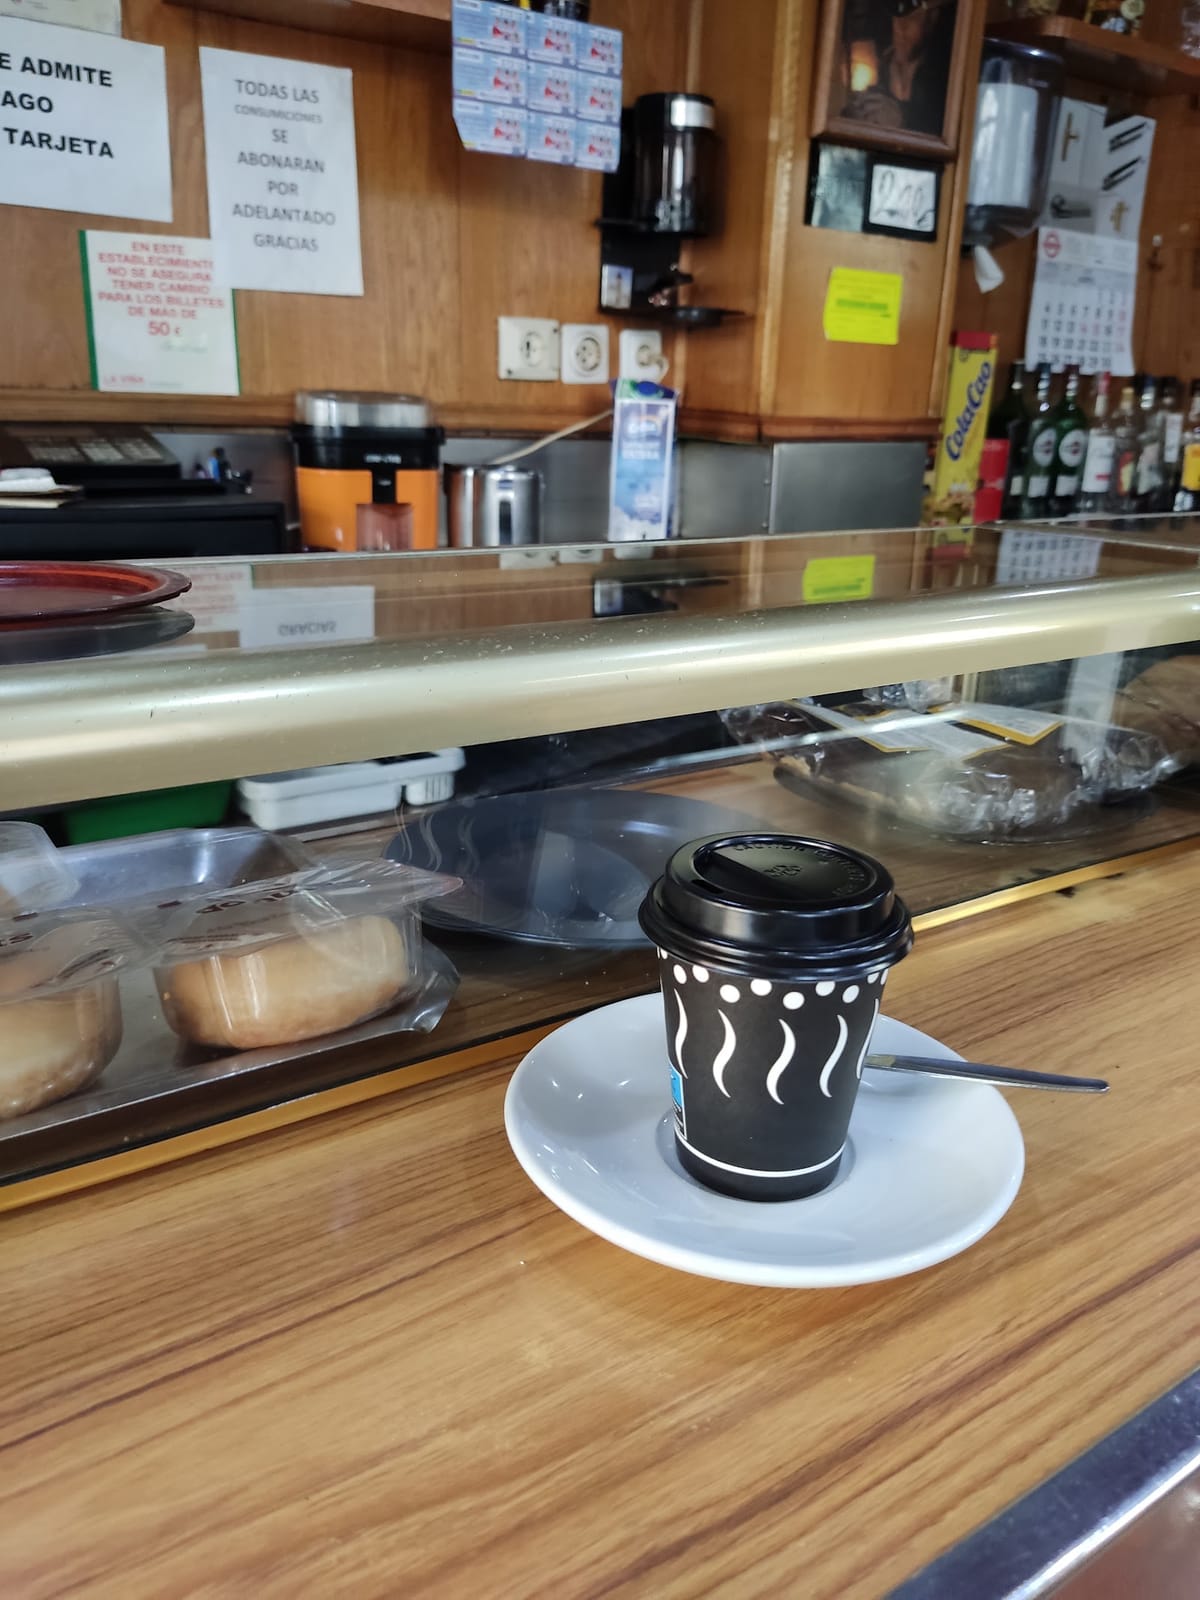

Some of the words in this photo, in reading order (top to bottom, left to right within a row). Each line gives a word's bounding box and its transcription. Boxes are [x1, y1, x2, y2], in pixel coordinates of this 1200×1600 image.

[0, 53, 12, 70] E
[20, 56, 113, 87] ADMITE
[235, 79, 288, 100] TODAS
[293, 88, 319, 104] LAS
[1, 90, 54, 113] AGO
[234, 104, 323, 124] CONSUMICIONES
[3, 127, 114, 158] TARJETA
[272, 129, 288, 144] SE
[237, 151, 325, 173] ABONARAN
[268, 180, 299, 196] POR
[233, 203, 336, 226] ADELANTADO
[131, 241, 149, 251] EN
[153, 243, 184, 255] ESTE
[254, 233, 319, 252] GRACIAS
[98, 253, 213, 270] ESTABLECIMIENT
[107, 267, 127, 277] NO
[131, 268, 146, 278] SE
[112, 280, 154, 291] TENER
[159, 282, 209, 294] CAMBIO
[98, 292, 132, 302] PARA
[137, 294, 162, 304] LOS
[167, 296, 224, 308] BILLETES
[128, 306, 145, 317] DE
[181, 309, 197, 319] DE
[148, 321, 170, 336] 50
